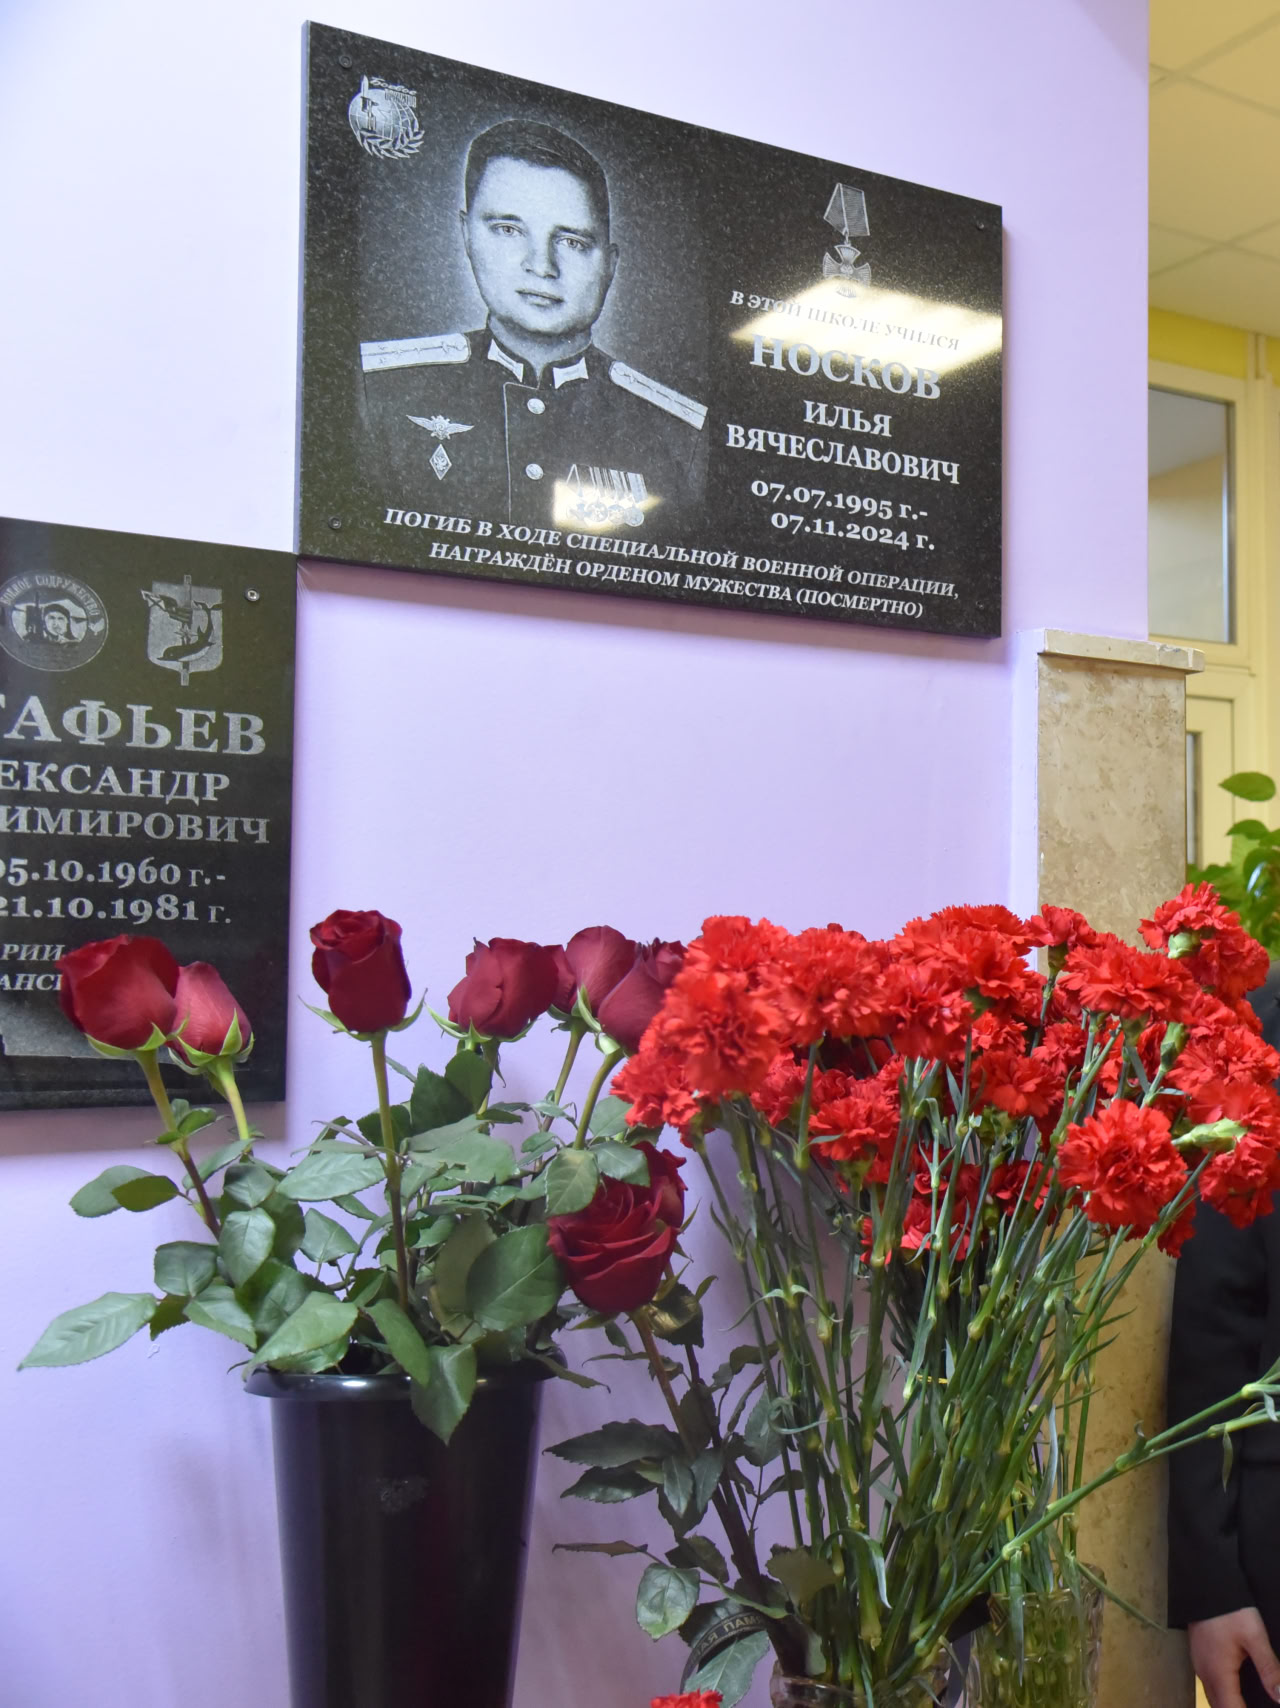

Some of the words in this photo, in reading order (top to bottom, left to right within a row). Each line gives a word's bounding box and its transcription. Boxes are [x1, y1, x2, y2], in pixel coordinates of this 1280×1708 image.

[730, 290, 745, 306] В
[747, 294, 801, 318] ЭТОЙ
[807, 307, 881, 334] ШКОЛЕ
[884, 323, 960, 350] УЧИЛСЯ
[750, 333, 941, 400] НОСКОВ
[803, 400, 892, 437] ИЛЬЯ
[726, 423, 960, 485] ВЯЧЕСЛАВОВИЧ
[751, 480, 893, 520] 07.07.1995
[383, 508, 472, 534] ПОГИБ
[475, 520, 492, 536] В
[496, 523, 562, 547] ХОДЕ
[566, 533, 737, 569] СПЕЦИАЛЬНОЙ
[742, 555, 845, 583] ВОЕННОЙ
[847, 570, 959, 600] ОПЕРАЦИИ,
[771, 512, 909, 550] 07.11.2024
[915, 533, 935, 550] г.
[429, 542, 573, 574] НАГРАЖДЁН
[576, 561, 680, 588] ОРДЕНОМ
[683, 574, 792, 602] МУЖЕСТВА
[796, 588, 924, 618] (ПОСМЕРТНО)
[0, 693, 266, 755] АФЬЕВ
[208, 905, 231, 924] г.
